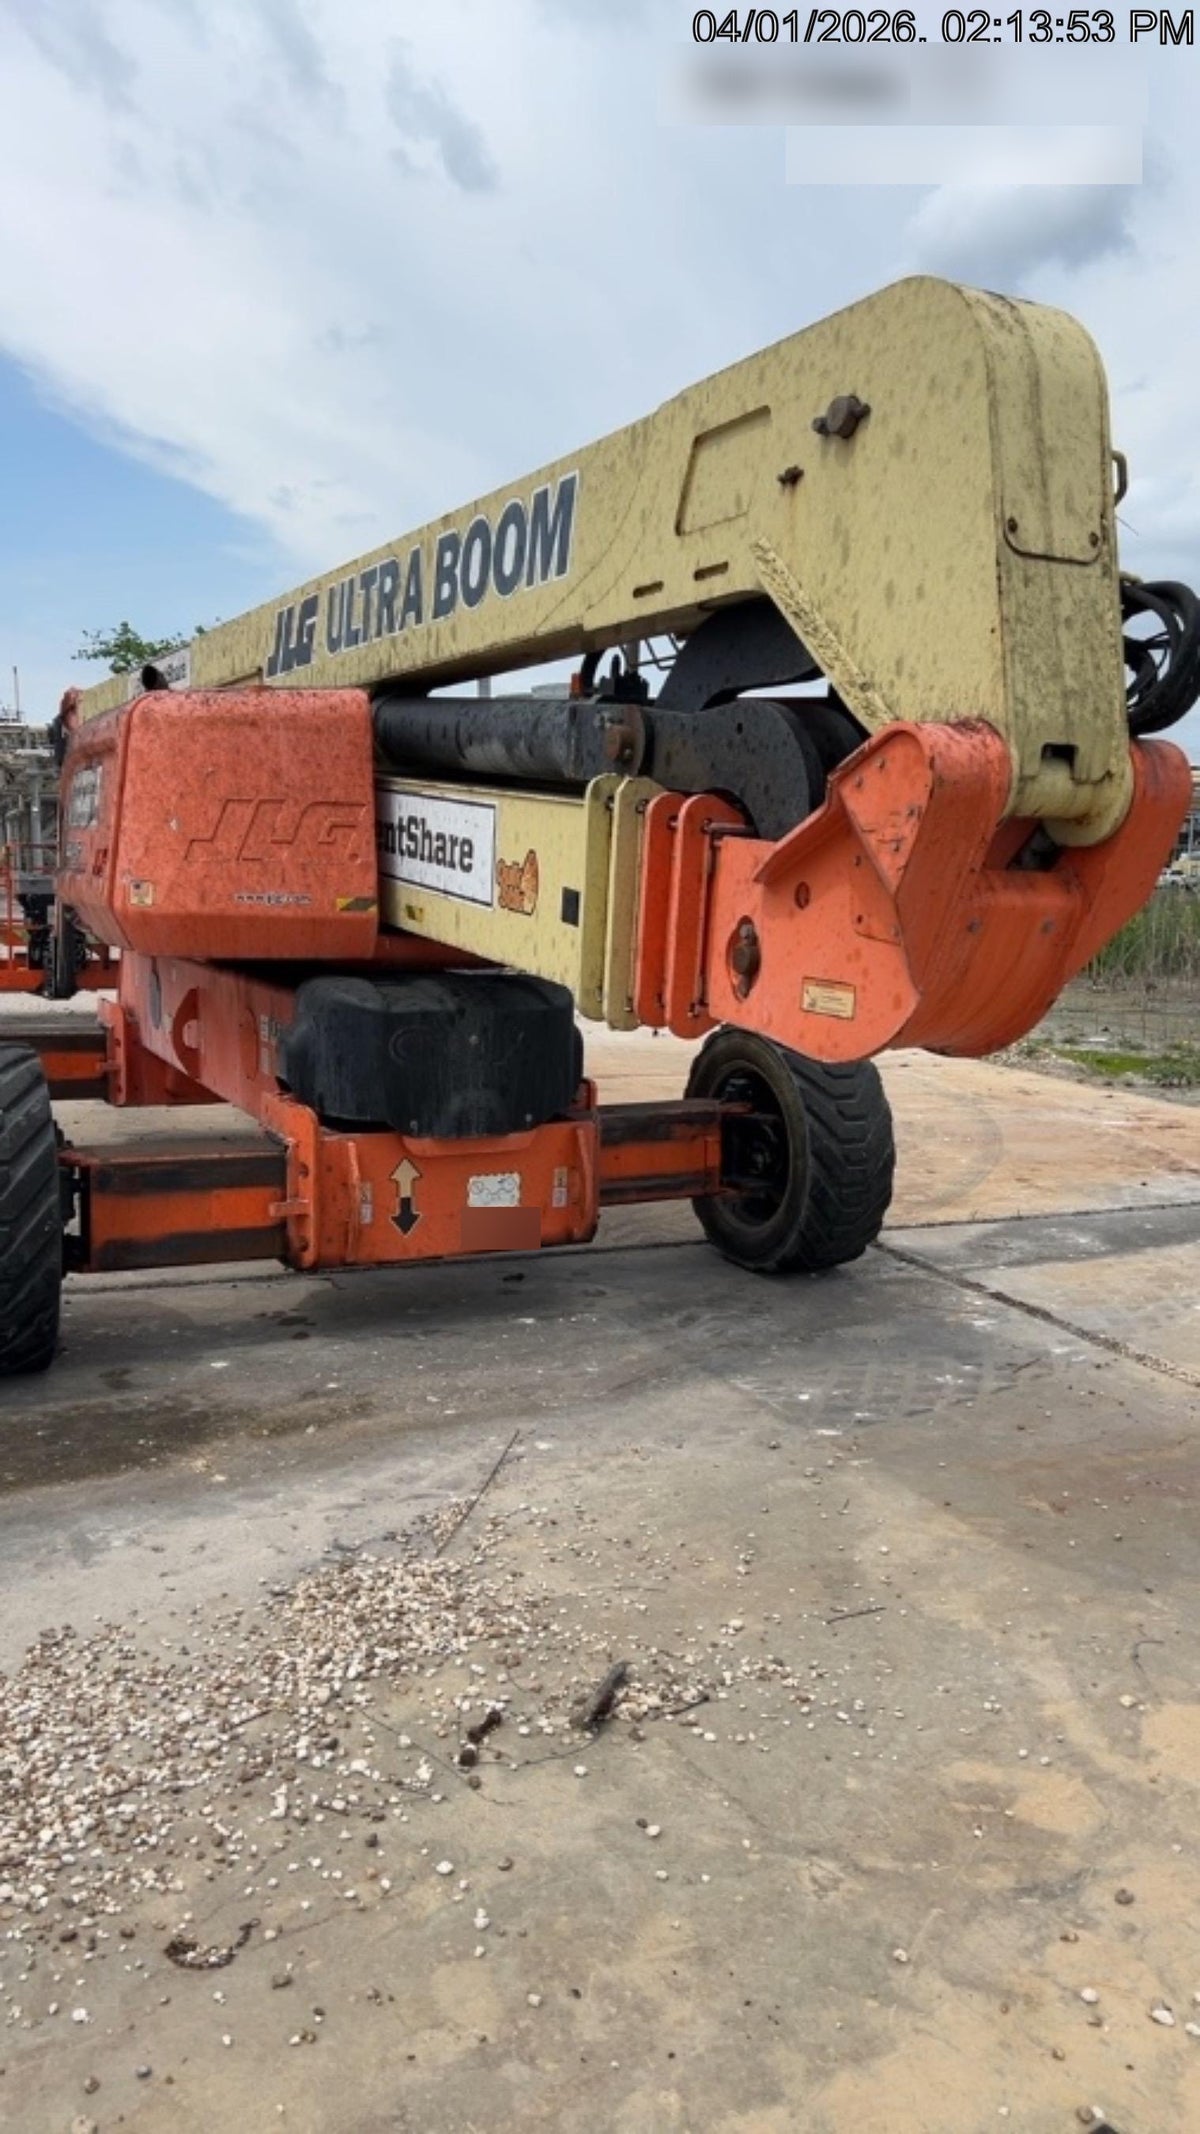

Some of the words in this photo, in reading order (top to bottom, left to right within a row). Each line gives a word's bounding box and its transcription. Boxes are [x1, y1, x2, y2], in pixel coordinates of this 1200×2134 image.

[264, 592, 320, 680] JLG
[325, 543, 424, 656] ULTRA
[431, 468, 580, 622] BOOM
[182, 796, 368, 864] JLG
